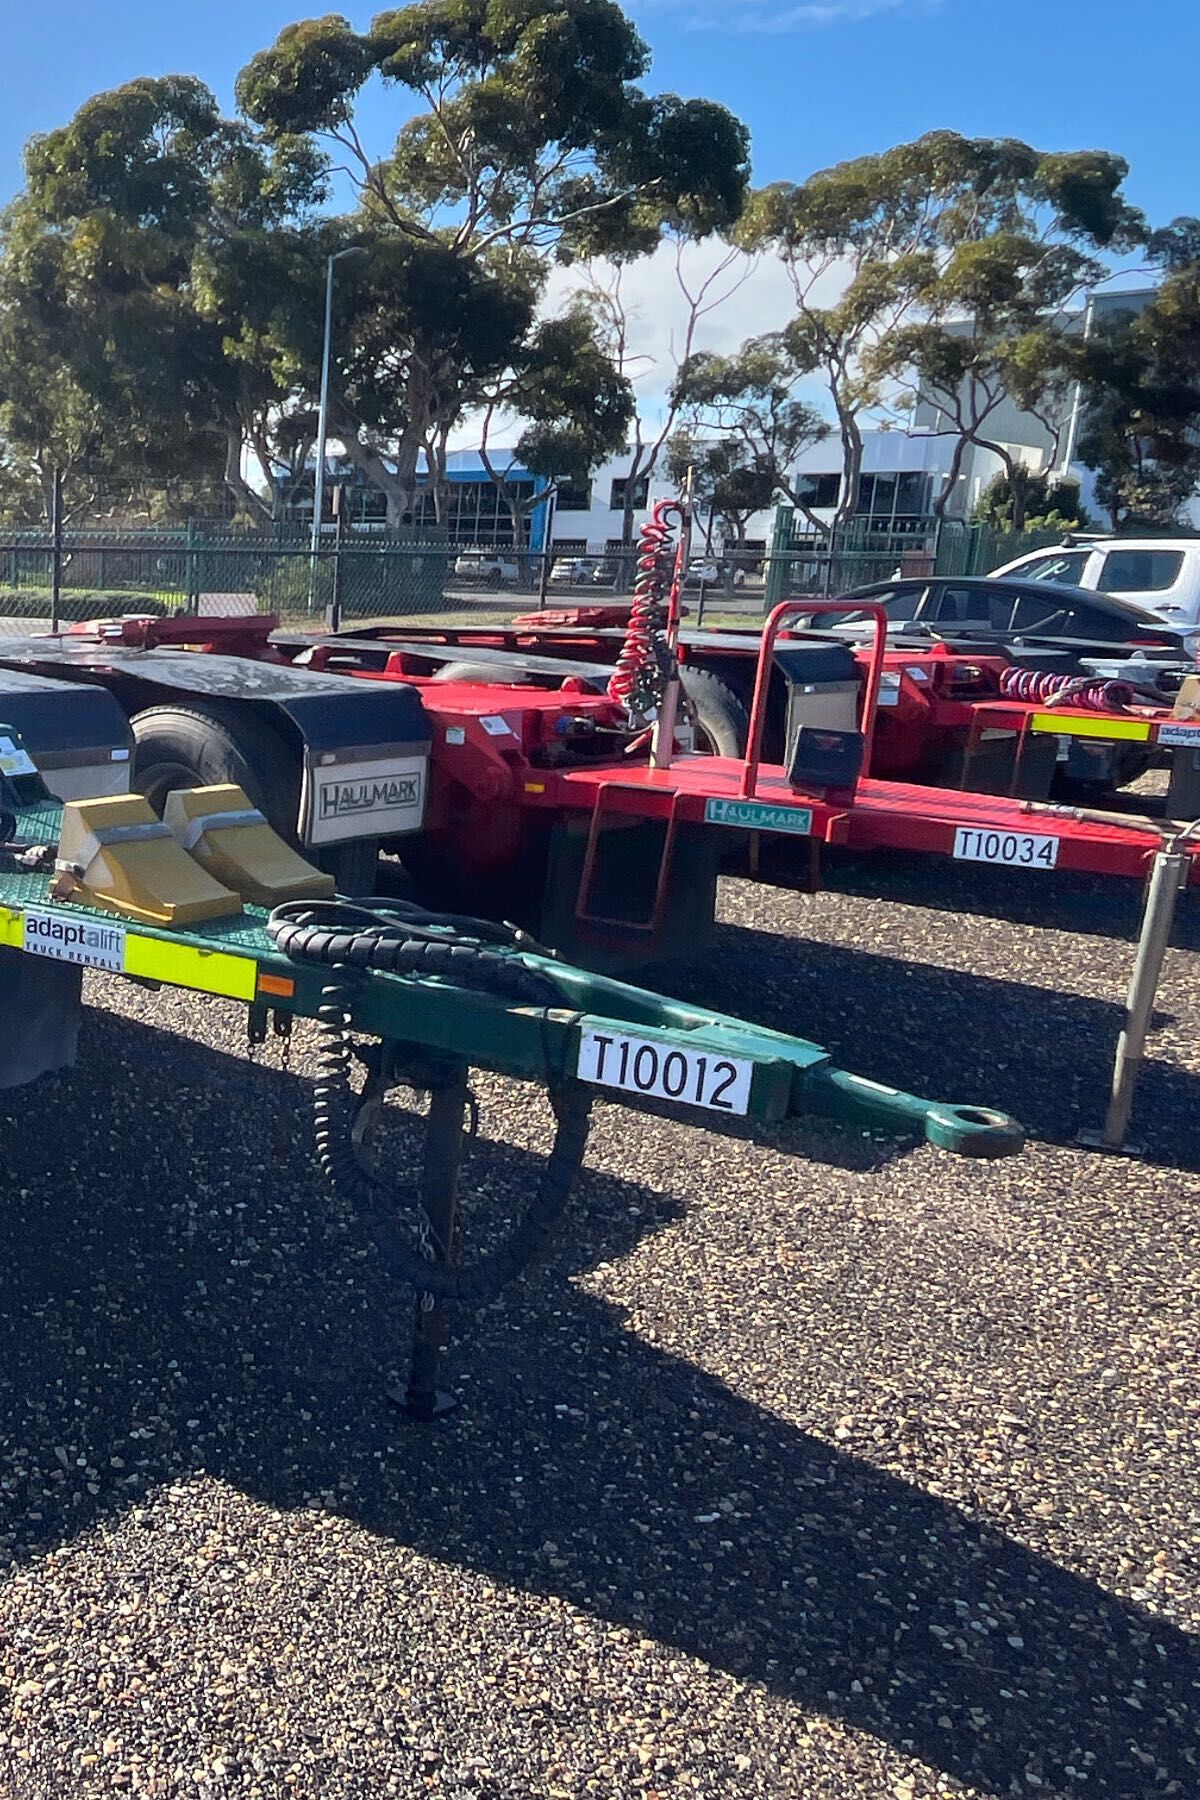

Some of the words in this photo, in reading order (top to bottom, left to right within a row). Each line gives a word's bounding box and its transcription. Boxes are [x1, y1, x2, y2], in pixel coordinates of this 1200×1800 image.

[323, 780, 417, 816] HAULMARK
[709, 800, 808, 829] HAULMARK
[961, 831, 1054, 866] T10034
[26, 917, 121, 953] adaptalift
[26, 941, 63, 957] TRUCK
[69, 951, 121, 971] RENTALS
[593, 1035, 737, 1109] T10012
